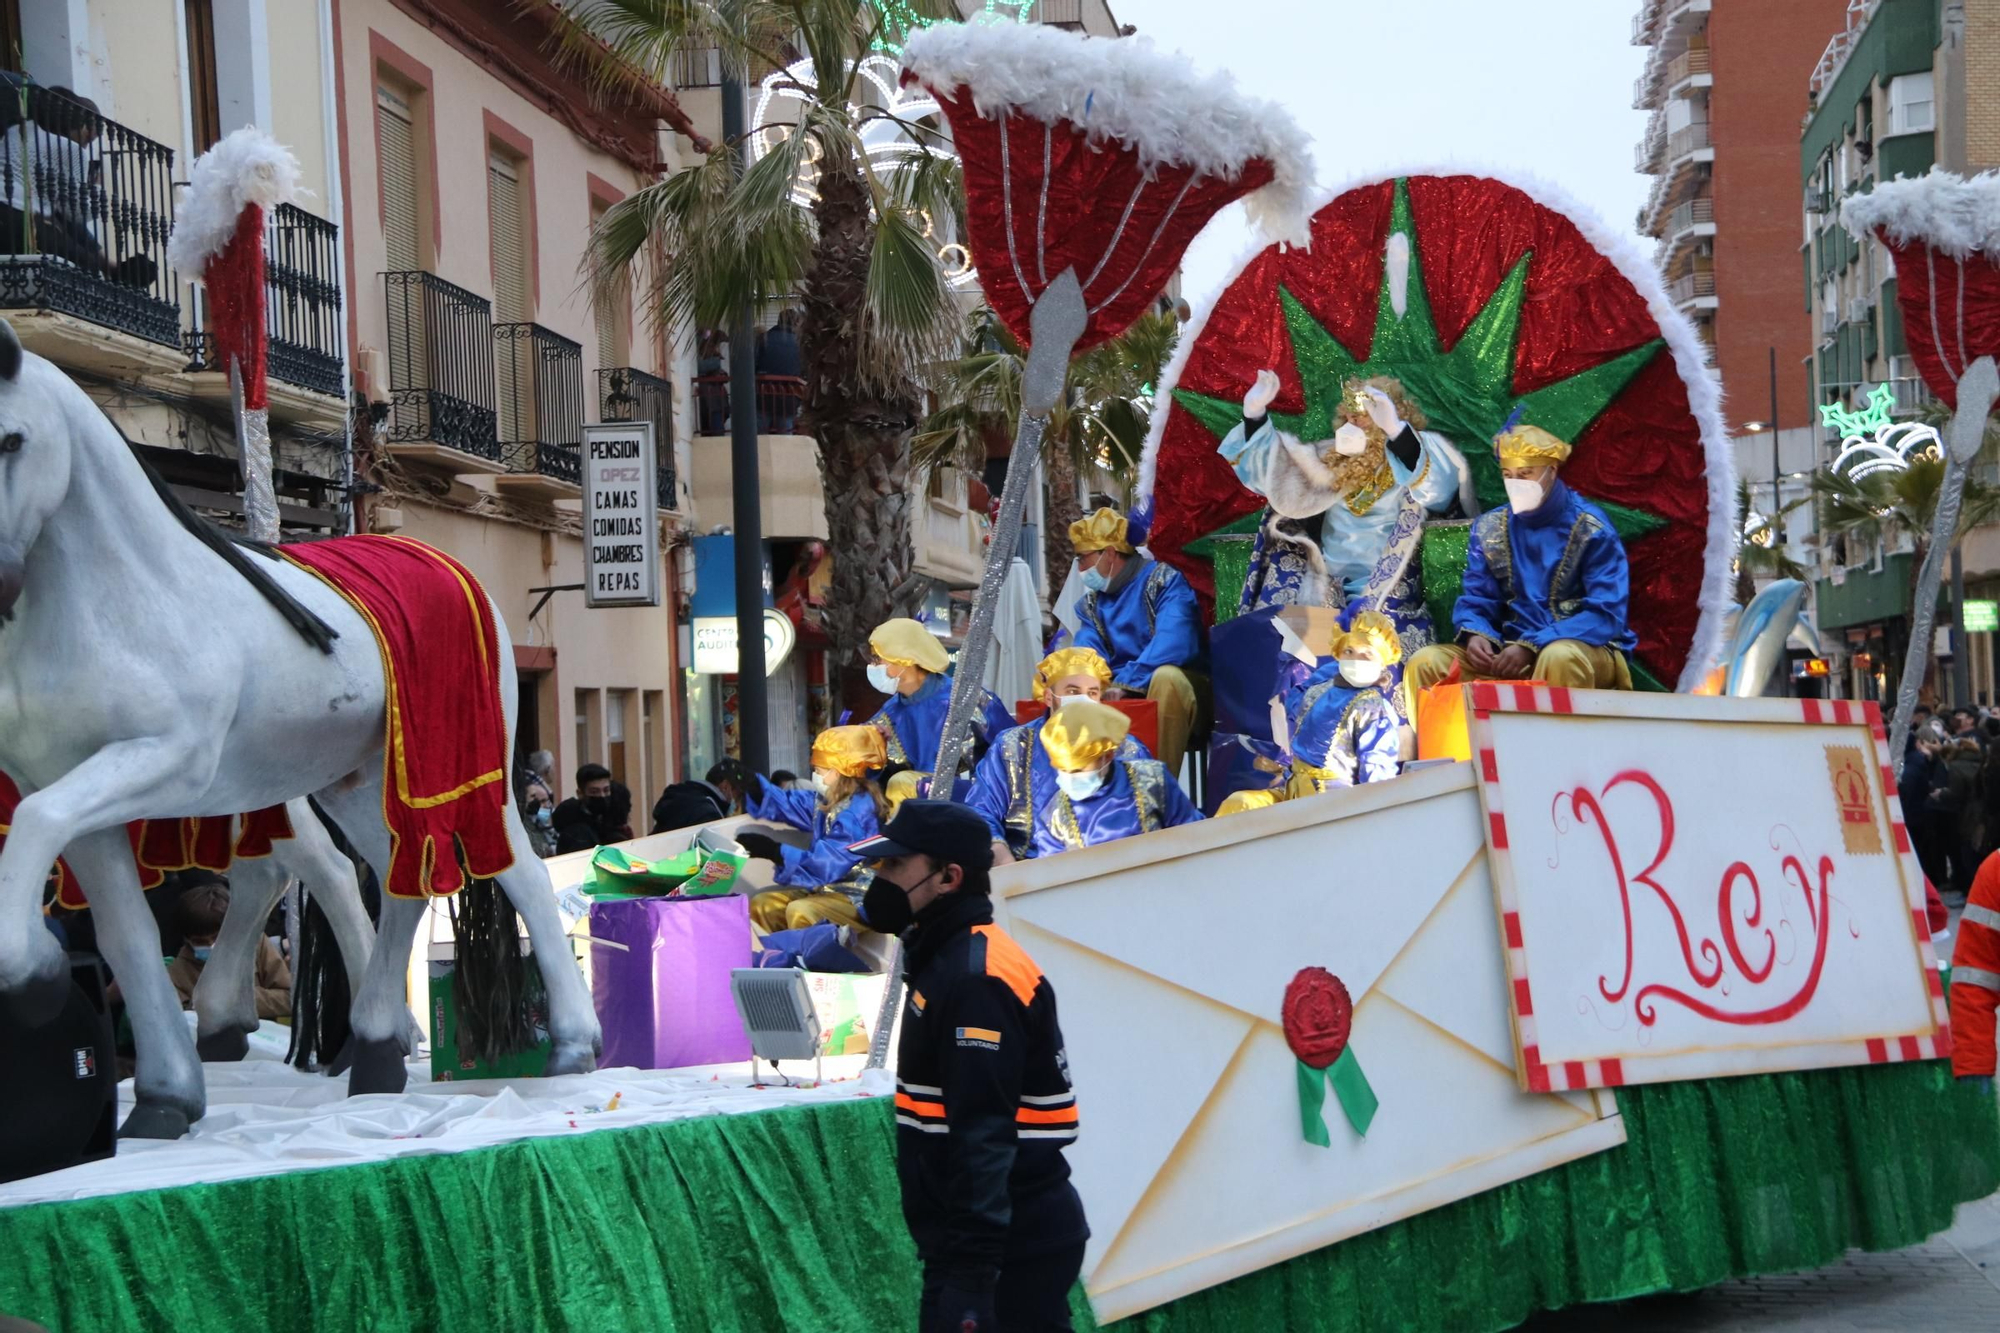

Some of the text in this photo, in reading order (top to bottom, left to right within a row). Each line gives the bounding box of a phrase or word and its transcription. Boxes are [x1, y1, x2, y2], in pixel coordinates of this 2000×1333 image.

[590, 440, 640, 459] PENSION
[599, 467, 641, 482] OPEZ
[595, 490, 638, 509] CAMAS
[593, 517, 642, 537] COMIDAS
[593, 544, 643, 564] CHAMBRES
[599, 572, 639, 591] REPAS
[1553, 768, 1838, 1028] Rey
[956, 1039, 1000, 1051] VOLUNTARIO
